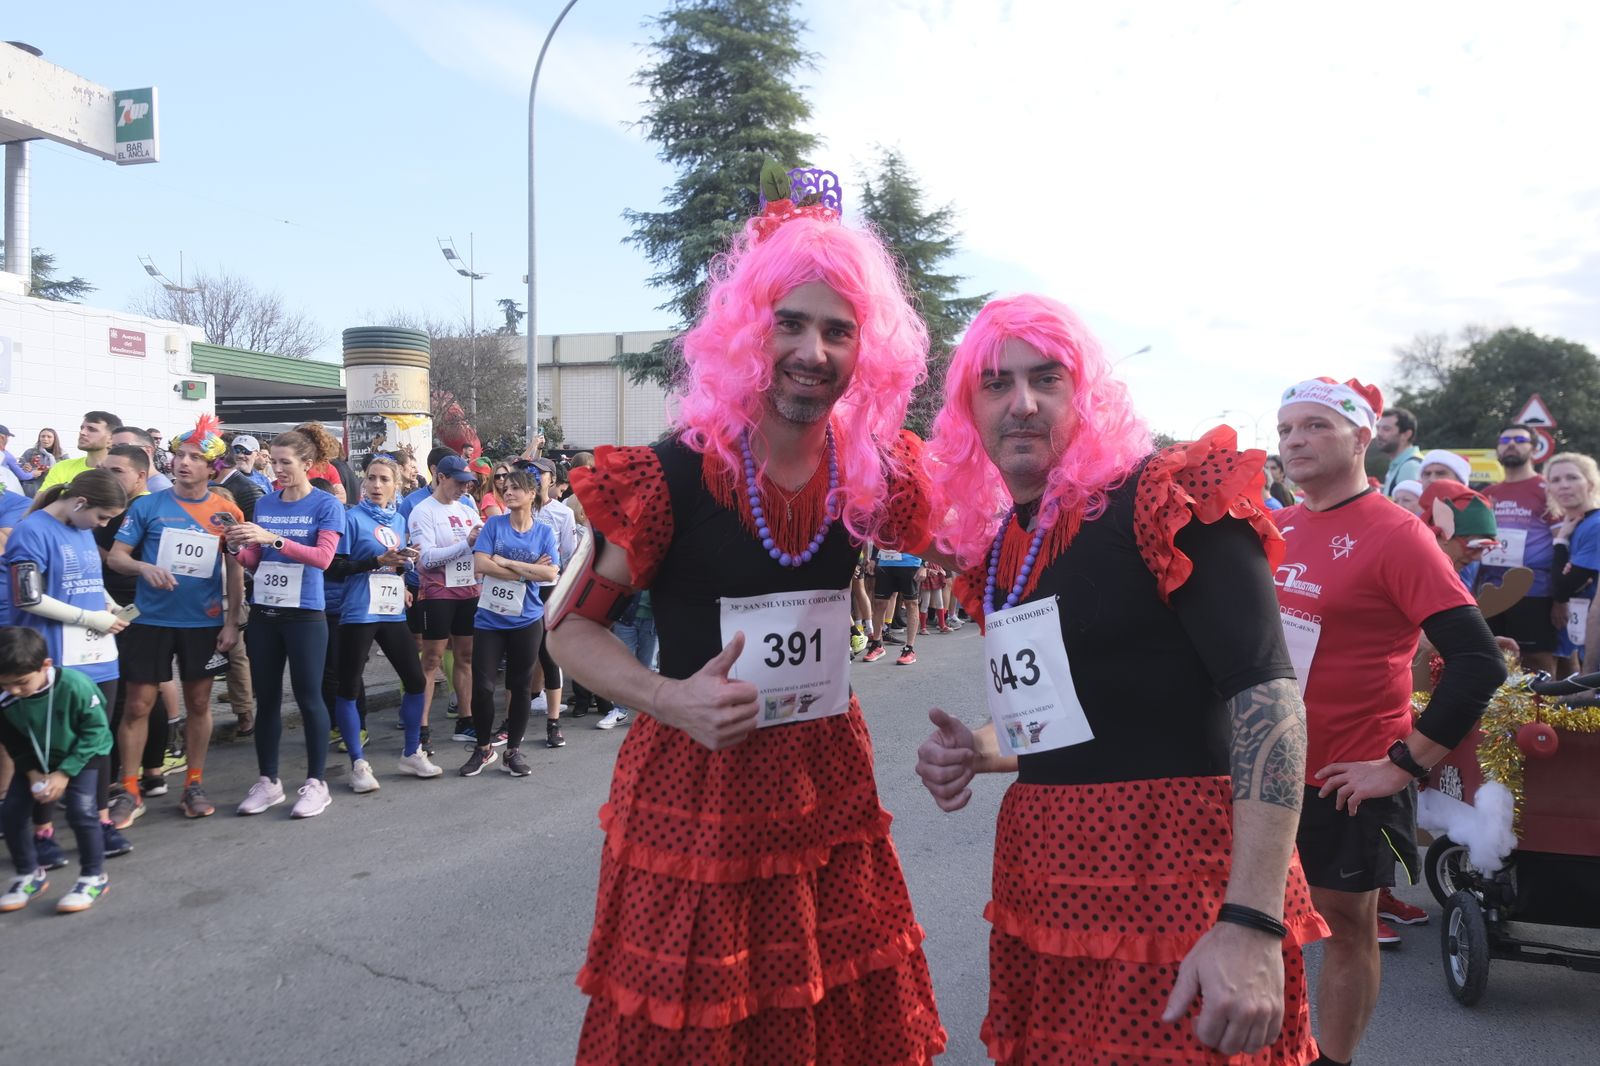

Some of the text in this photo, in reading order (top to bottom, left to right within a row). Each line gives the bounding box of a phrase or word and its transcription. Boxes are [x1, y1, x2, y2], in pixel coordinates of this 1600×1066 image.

[126, 142, 142, 152] BAR
[118, 149, 150, 160] EL ANCLA
[122, 334, 142, 342] Avenida
[391, 399, 401, 409] DE
[289, 516, 298, 524] QUE
[308, 516, 313, 524] A
[289, 529, 309, 537] PORQUE
[175, 542, 204, 558] 100
[263, 573, 288, 588] 389
[380, 585, 398, 598] 774
[491, 586, 514, 601] 685
[743, 602, 761, 611] SAN
[761, 598, 807, 609] SILVESTRE
[808, 594, 846, 605] CORDOBESA
[1005, 606, 1055, 625] CORDOBESA
[763, 628, 822, 669] 391
[989, 648, 1041, 694] 843
